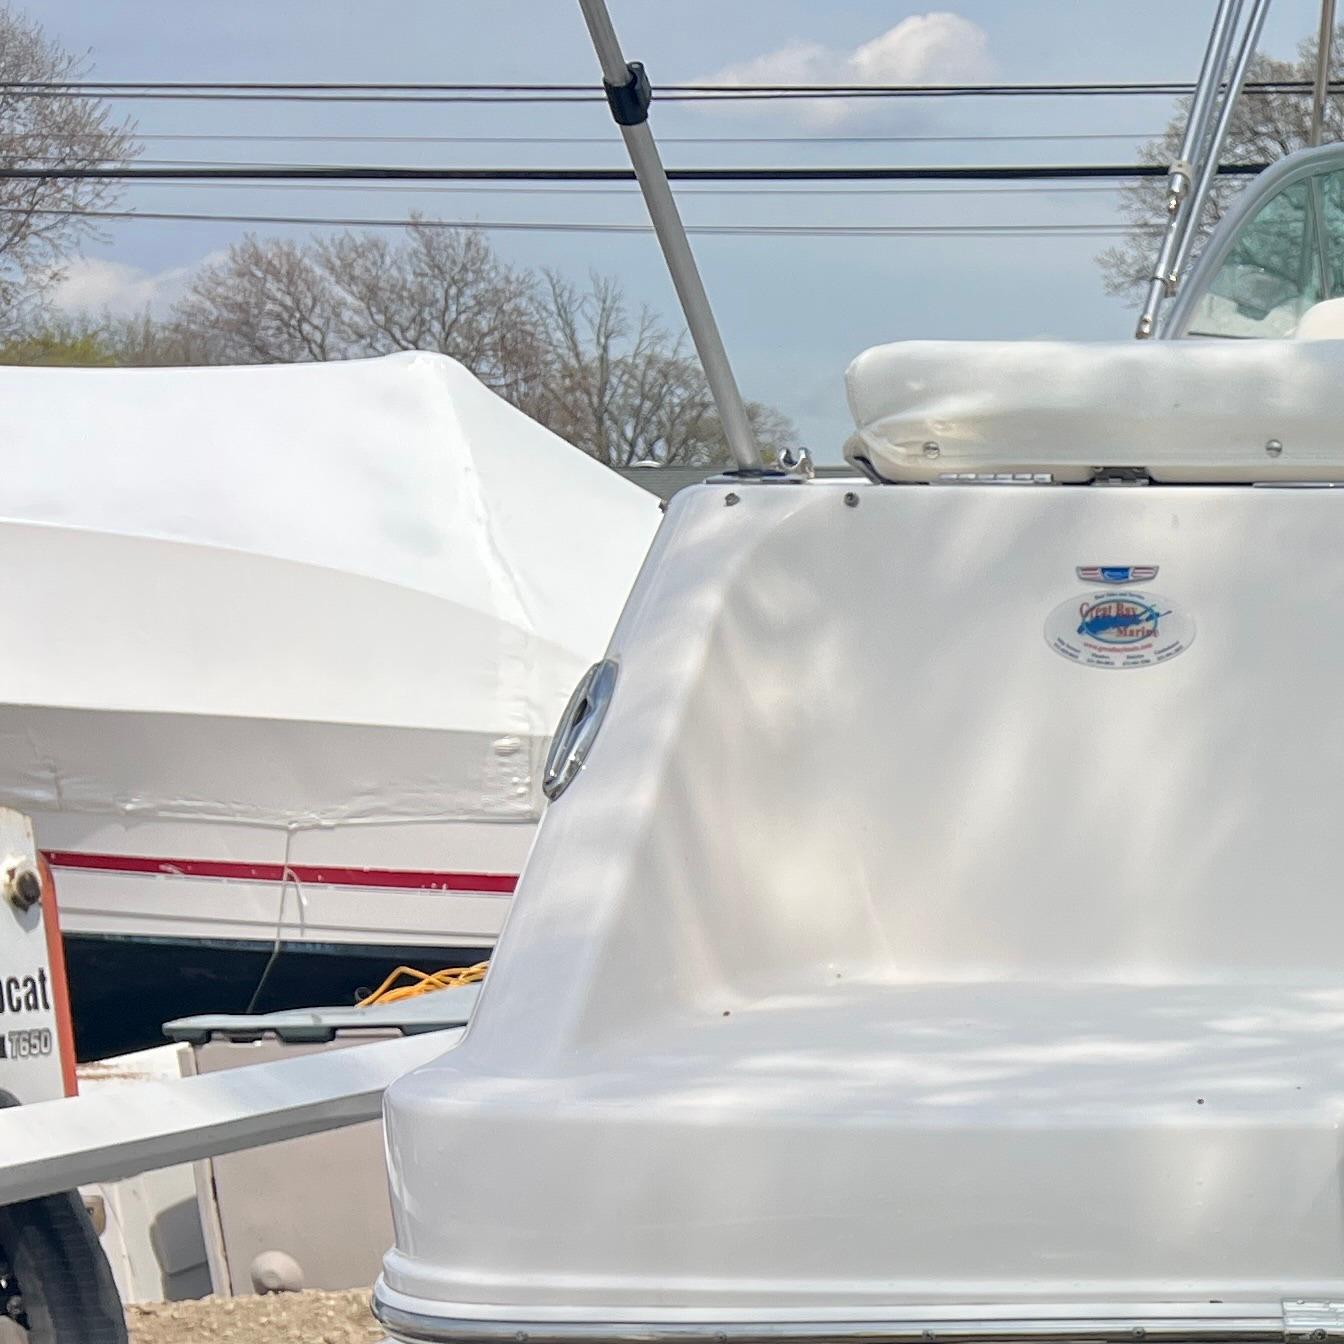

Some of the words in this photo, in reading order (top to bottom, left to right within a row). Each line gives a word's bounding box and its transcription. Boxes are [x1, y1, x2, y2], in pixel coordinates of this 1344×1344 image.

[1080, 602, 1112, 618] Great
[1116, 602, 1138, 617] Bay
[1116, 626, 1160, 638] Marine
[8, 1028, 52, 1059] T650
